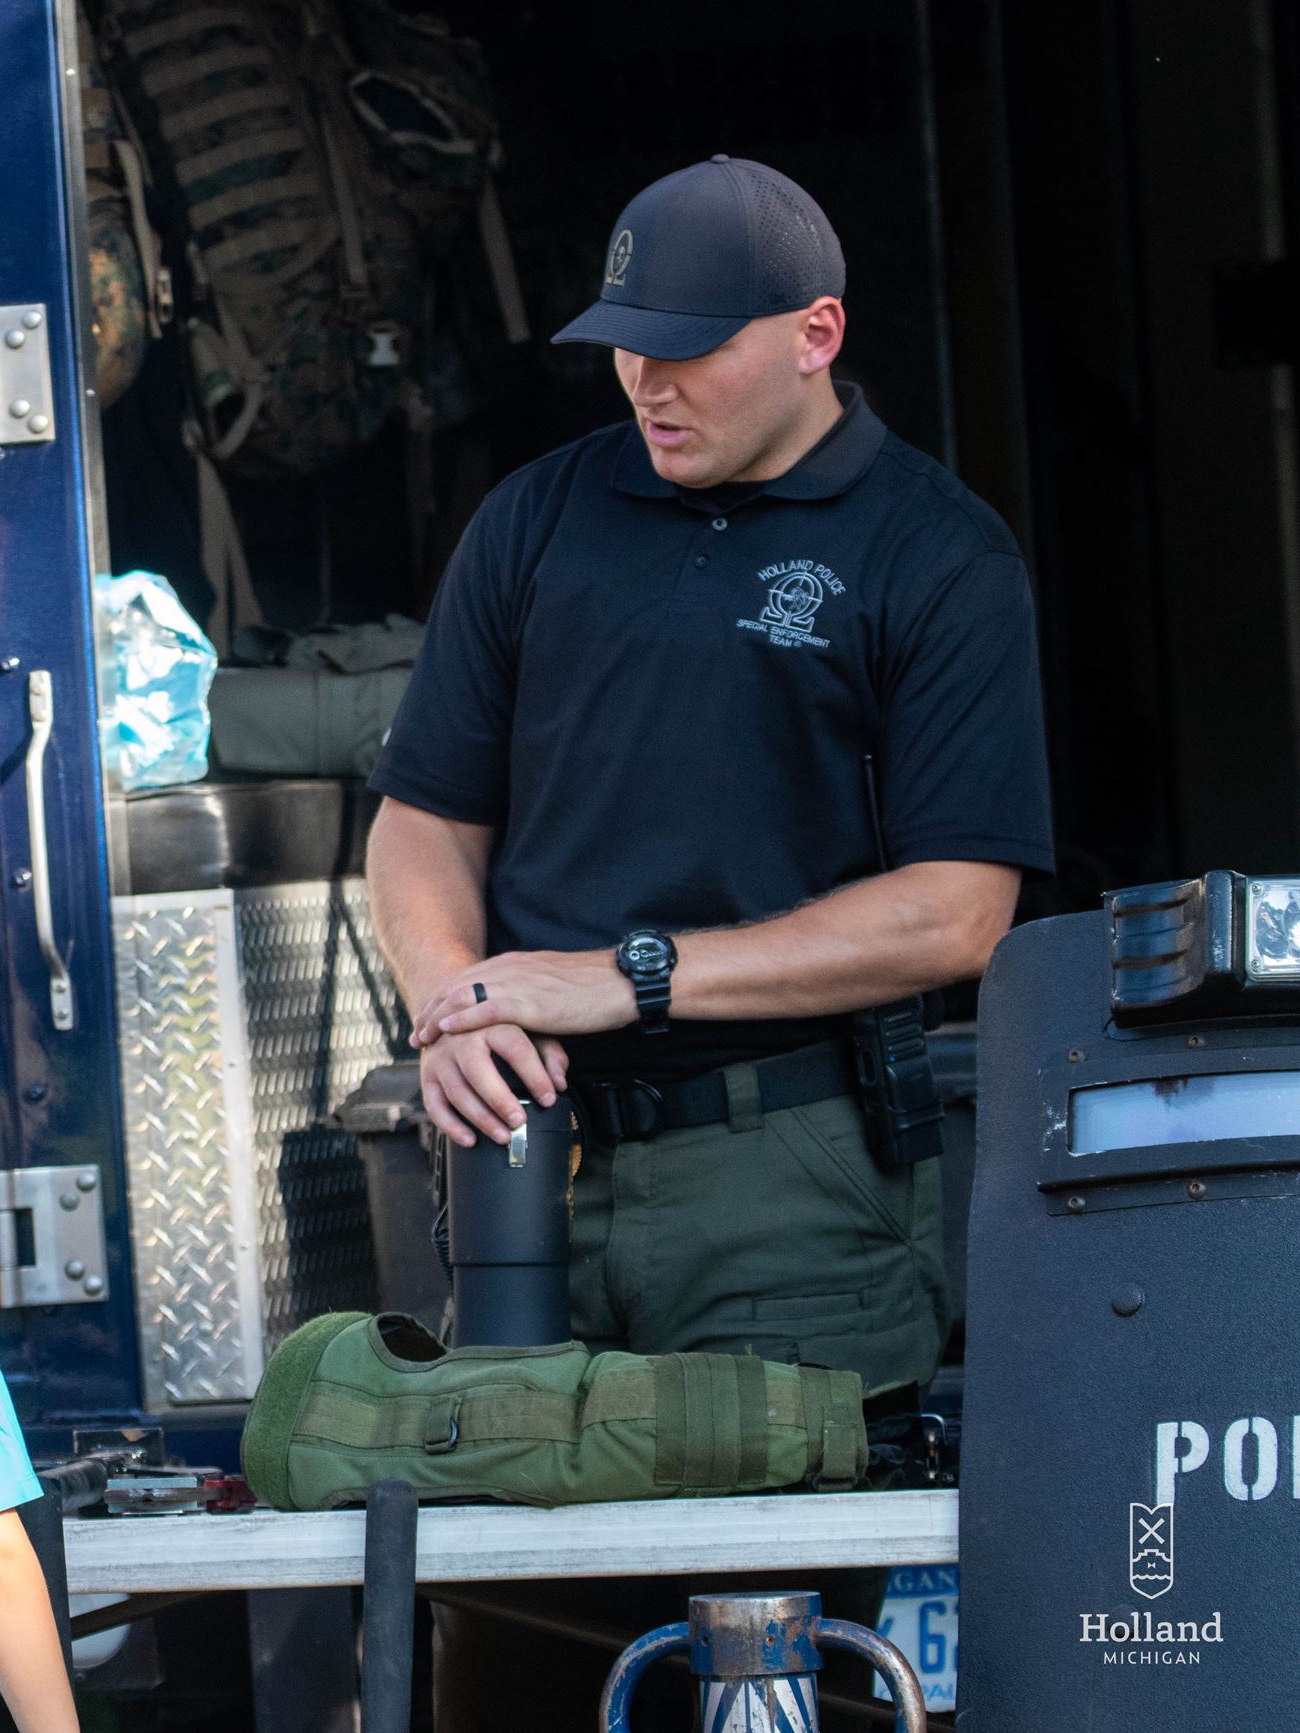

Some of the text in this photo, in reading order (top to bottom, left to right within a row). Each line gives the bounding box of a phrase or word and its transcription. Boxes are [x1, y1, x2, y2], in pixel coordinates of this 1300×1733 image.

[757, 559, 847, 596] HOLLAND POLICE
[736, 618, 768, 632] SPECIAL
[770, 626, 831, 648] ENFORCEMENT
[769, 634, 792, 647] TEAM
[1156, 1414, 1300, 1506] PO
[887, 1569, 957, 1594] GAN
[919, 1601, 958, 1673] 6
